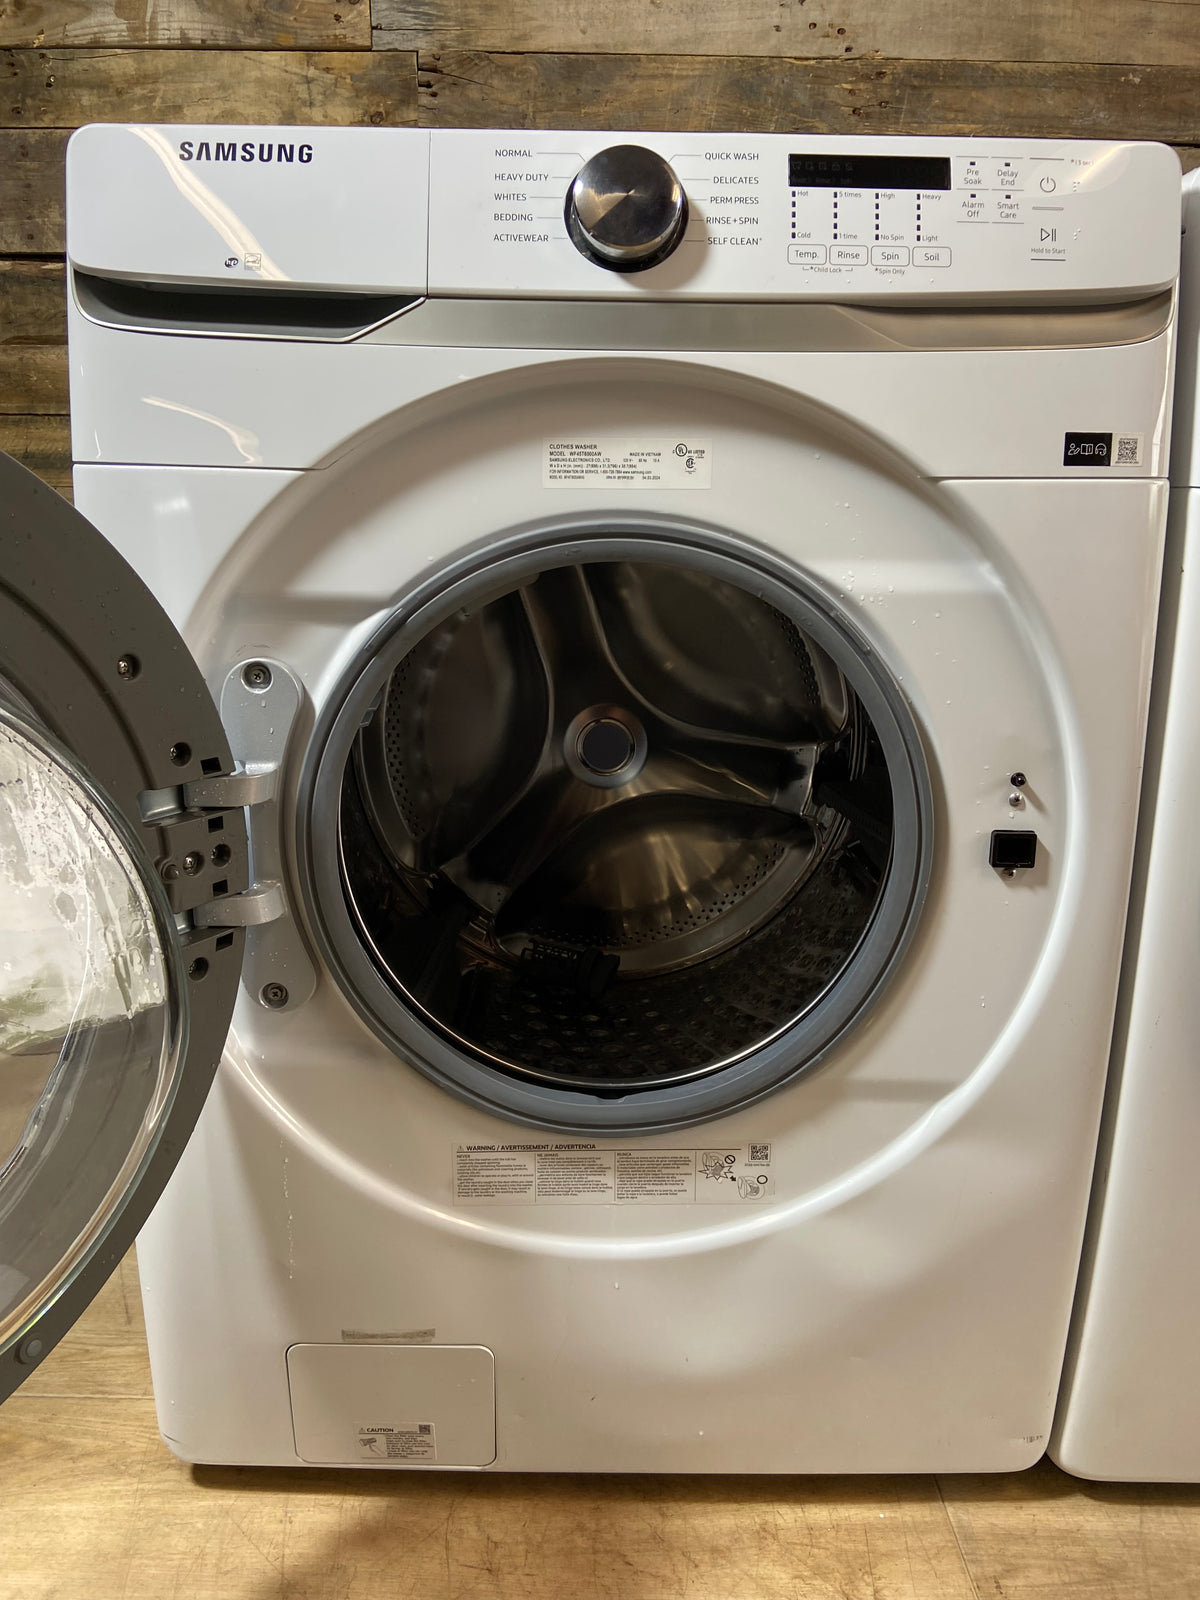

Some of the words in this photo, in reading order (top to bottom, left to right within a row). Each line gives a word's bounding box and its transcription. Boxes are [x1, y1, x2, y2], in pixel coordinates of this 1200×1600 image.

[179, 141, 313, 163] SAMSUNG
[495, 149, 532, 158] NORMAL
[704, 152, 732, 161] QUICK
[733, 152, 759, 161] WASH
[966, 168, 979, 176] Pre
[997, 169, 1019, 178] Delay
[494, 173, 524, 182] HEAVY
[525, 173, 549, 182] DUTY
[713, 176, 759, 184] DELICATES
[963, 177, 982, 185] Soak
[1000, 178, 1015, 186] End
[494, 193, 527, 201] WHITES
[844, 191, 862, 199] times
[880, 192, 896, 200] High
[922, 193, 942, 201] Heavy
[710, 196, 733, 204] PERM
[734, 196, 759, 205] PRESS
[961, 201, 985, 209] Alarm
[997, 202, 1019, 210] Smart
[493, 213, 533, 222] BEDDING
[967, 210, 980, 218] Off
[1000, 211, 1017, 219] Care
[706, 216, 732, 225] RINSE
[738, 217, 759, 225] SPIN
[493, 234, 549, 242] ACTIVEWEAR
[707, 237, 728, 245] SELF
[890, 234, 905, 242] Spin
[795, 249, 819, 259] Temp.
[837, 250, 861, 260] Rinse
[881, 252, 900, 261] Spin
[924, 253, 940, 261] Soil
